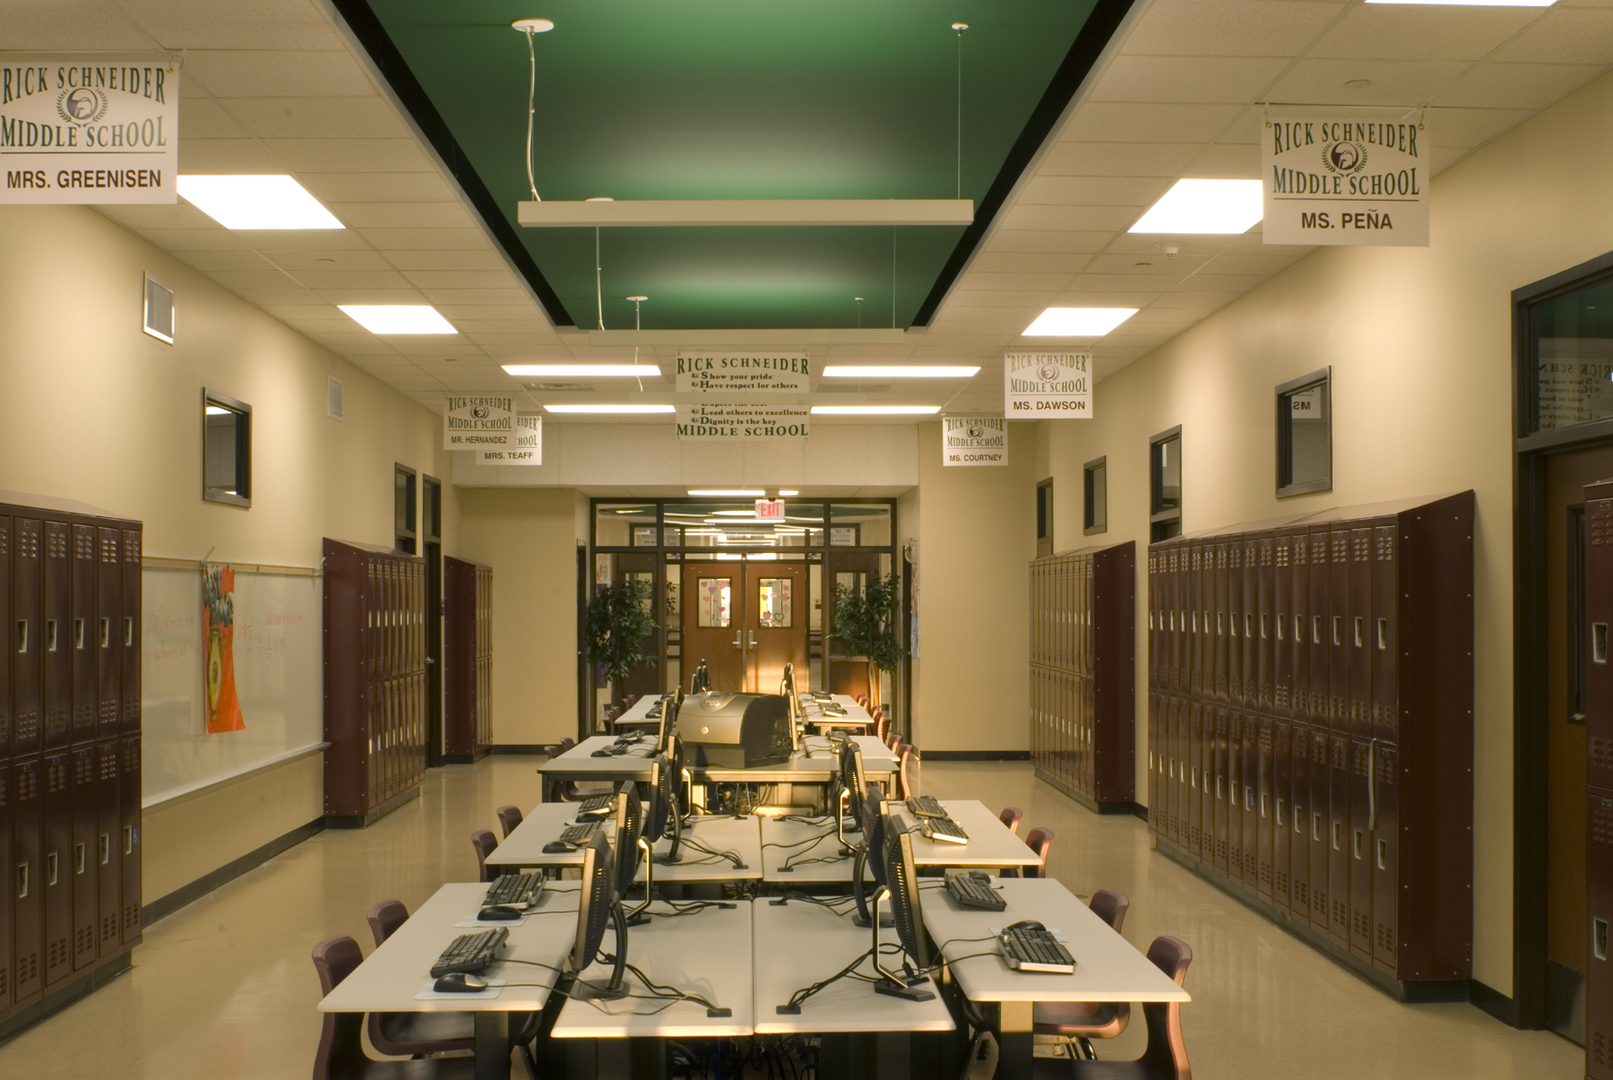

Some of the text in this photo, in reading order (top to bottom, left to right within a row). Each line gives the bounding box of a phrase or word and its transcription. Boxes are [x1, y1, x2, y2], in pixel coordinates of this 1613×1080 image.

[3, 66, 165, 105] RICK SCHNEIDER
[0, 115, 166, 147] MIDDLE SCHOOL
[1274, 122, 1418, 158] RICK SCHNEIDER
[7, 169, 161, 188] MRS. GREENISEN
[1273, 165, 1420, 196] MIDDLE SCHOOL
[1301, 209, 1393, 230] MS. PEÑA
[677, 357, 809, 375] RICK SCHNEIDER
[1011, 354, 1086, 373] RICK SCHNEIDER
[701, 371, 727, 380] Show
[750, 373, 773, 381] pride
[700, 380, 724, 389] Have
[1010, 377, 1087, 393] MIDDLE SCHOOL
[449, 397, 512, 413] RICK SCHNEIDER
[701, 407, 724, 416] Lead
[1013, 401, 1085, 410] MS. DAWSON
[448, 415, 512, 429] MIDDLE SCHOOL
[517, 417, 538, 431] EIDER
[700, 416, 735, 425] Dignity
[762, 418, 777, 426] key
[947, 418, 1004, 432] RICK SCHNEIDER
[676, 423, 808, 436] MIDDLE SCHOOL
[451, 435, 508, 444] MR. HERNANDEZ
[516, 434, 538, 446] HOOL
[947, 435, 1004, 447] MIDDLE SCHOOL
[507, 451, 534, 459] TEAFF
[949, 454, 1002, 462] MS. COURTNEY
[760, 502, 780, 517] EXIT
